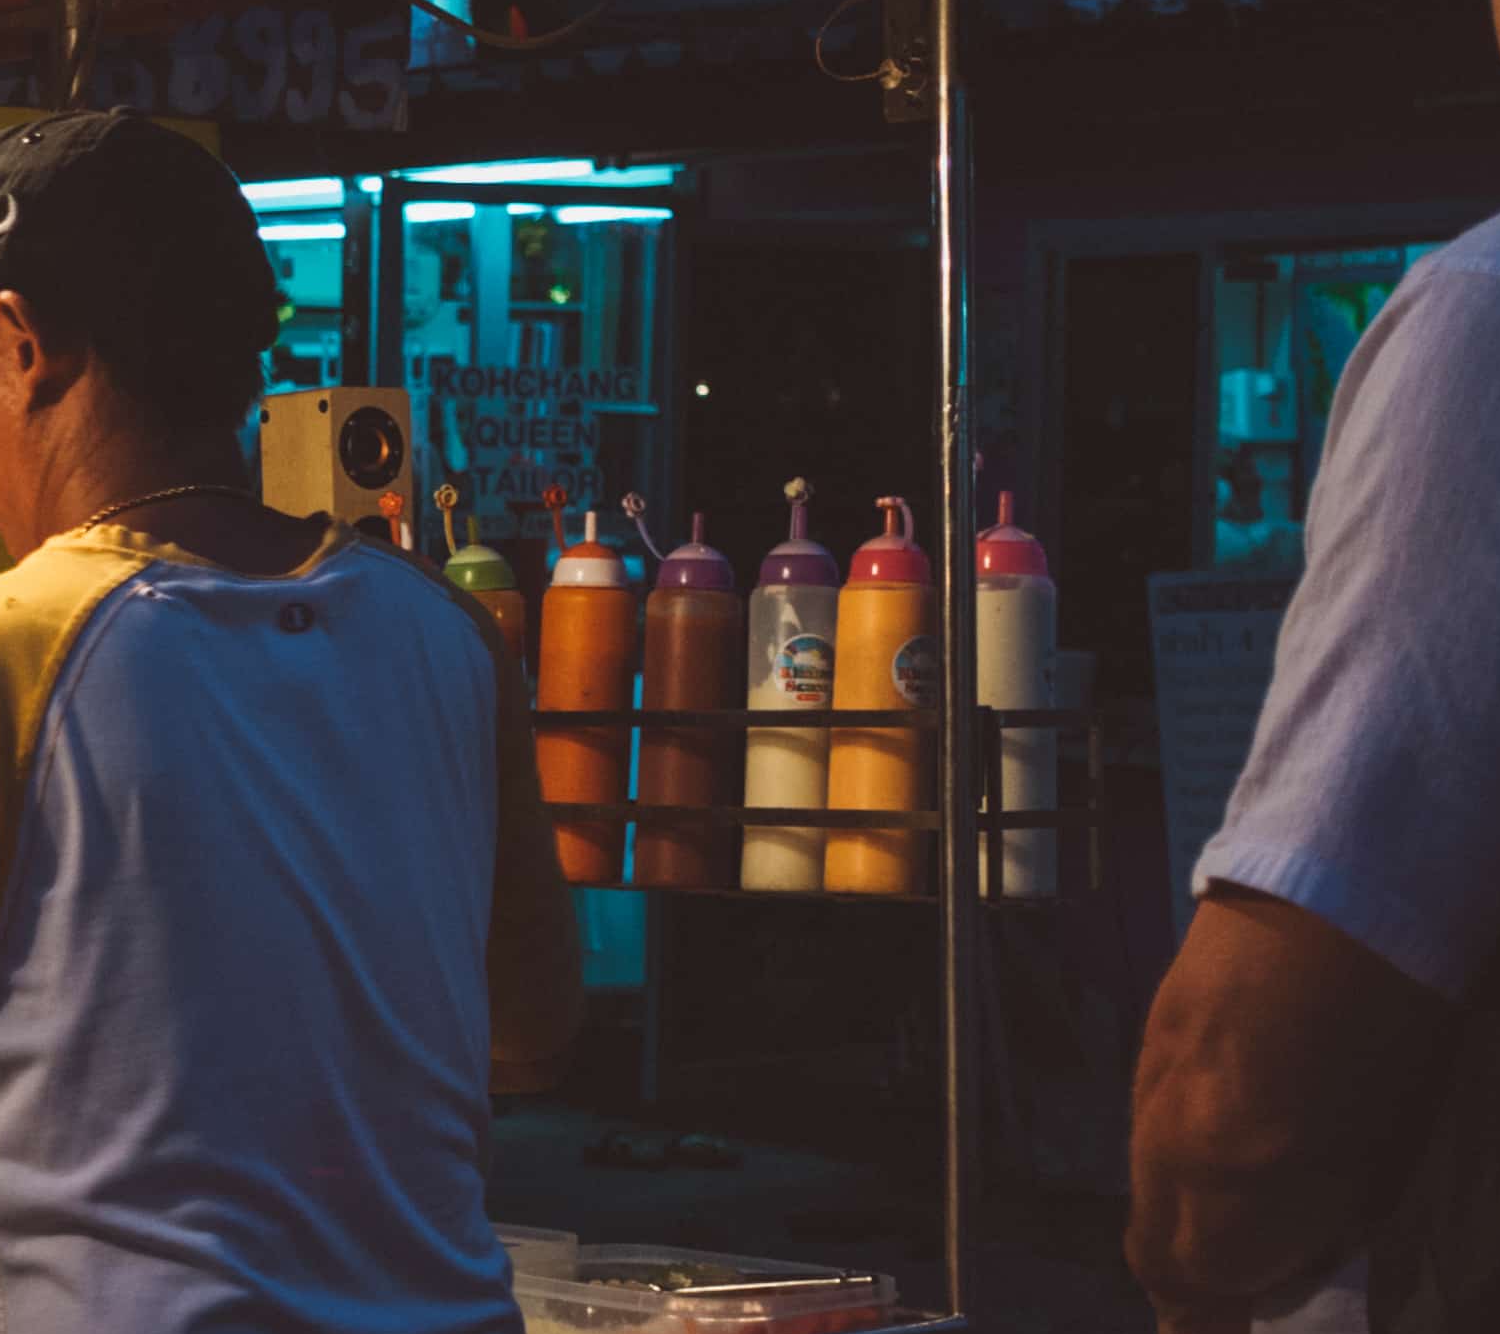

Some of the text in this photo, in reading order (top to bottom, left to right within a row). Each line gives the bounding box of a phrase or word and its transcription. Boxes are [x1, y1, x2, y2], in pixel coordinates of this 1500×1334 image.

[435, 366, 636, 399] KOHCHANG
[475, 417, 596, 448] QUEEN
[475, 467, 601, 498] TAILOR
